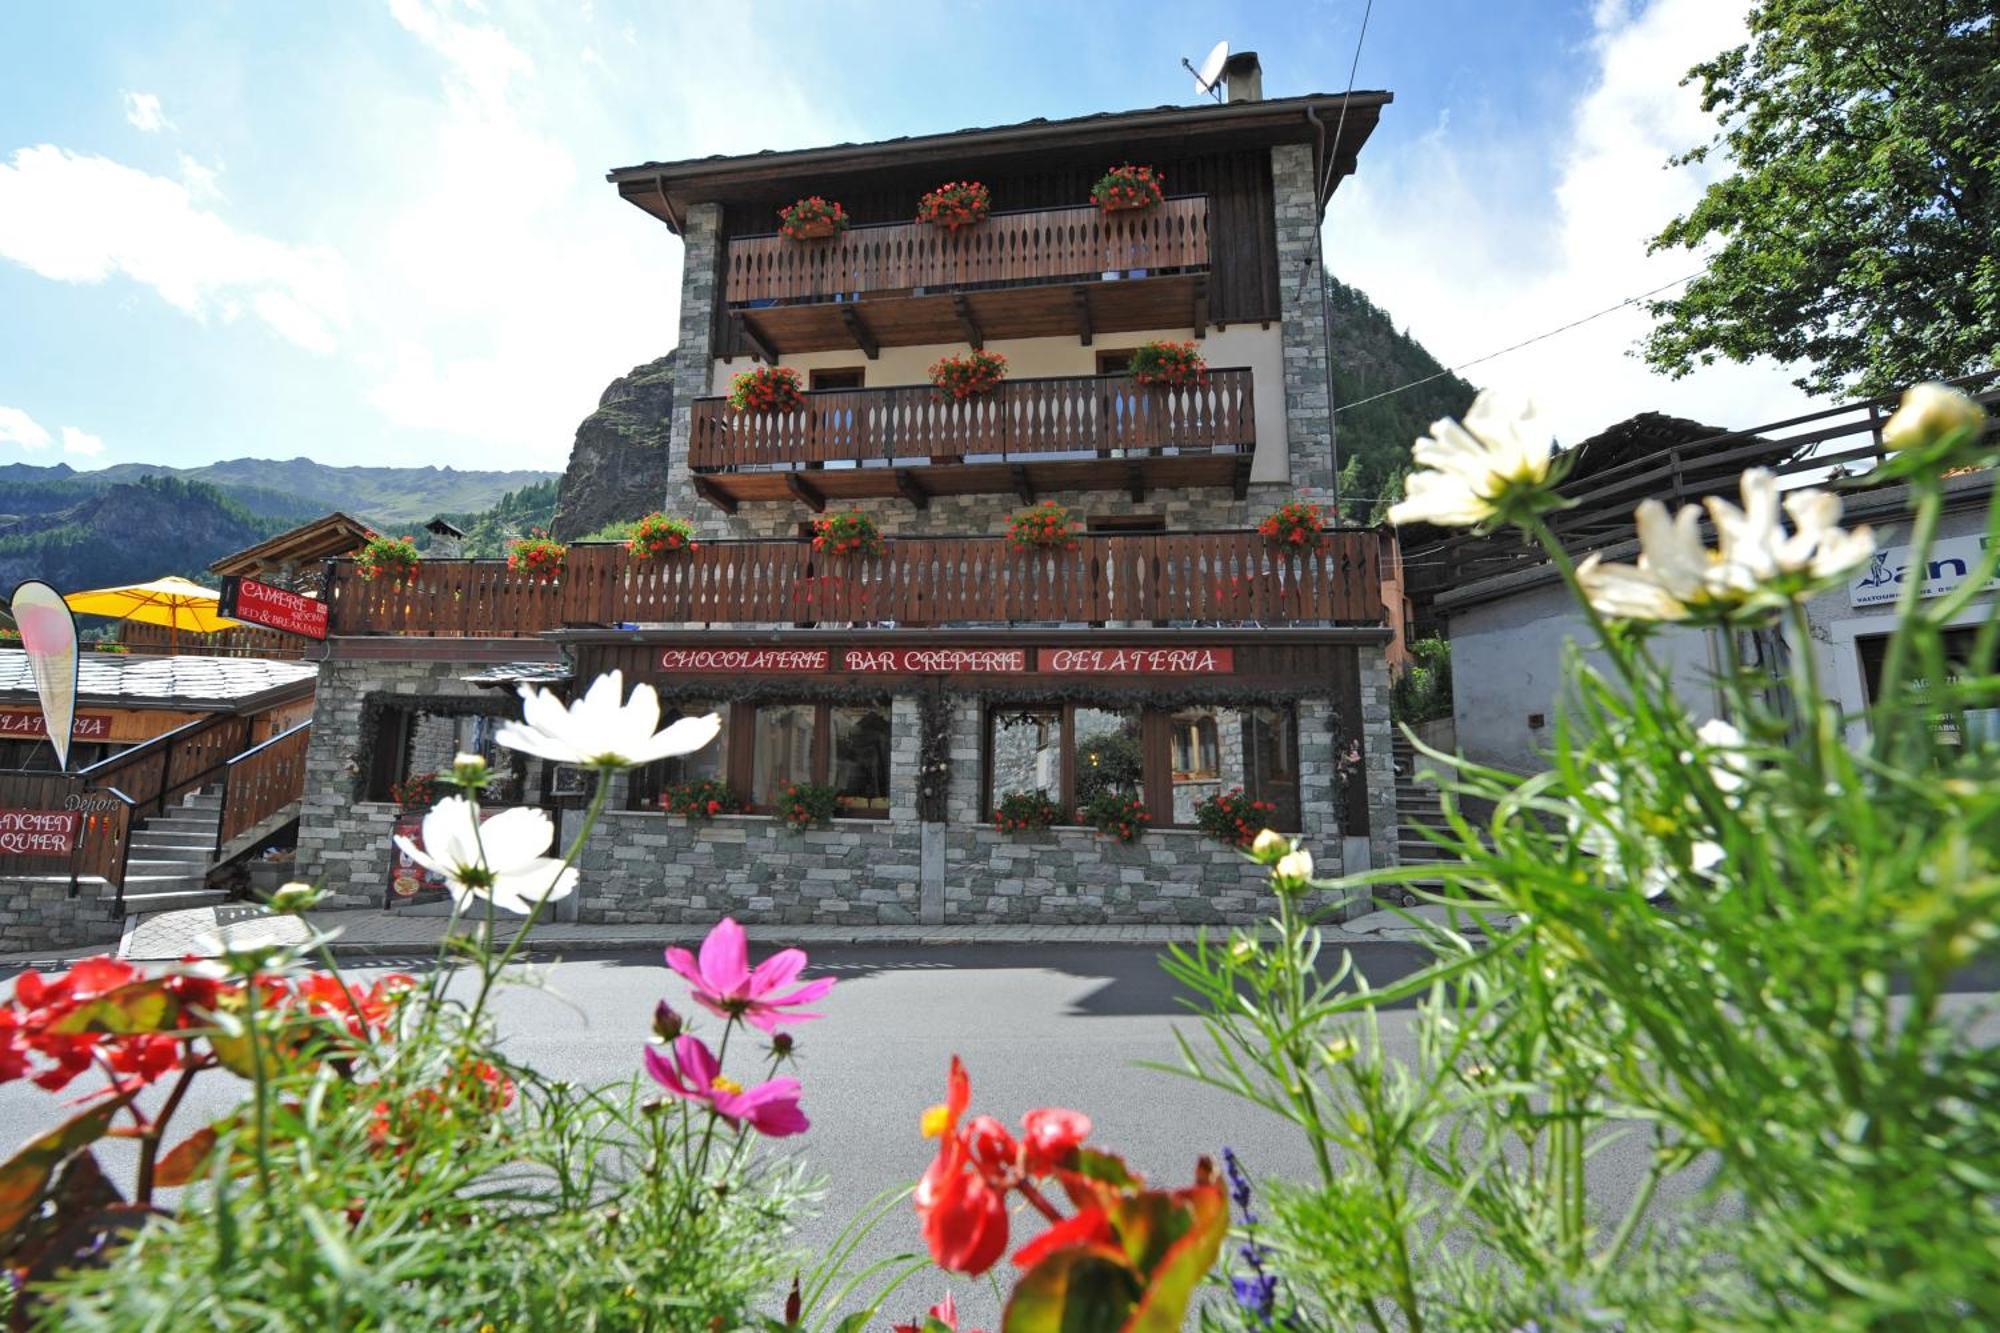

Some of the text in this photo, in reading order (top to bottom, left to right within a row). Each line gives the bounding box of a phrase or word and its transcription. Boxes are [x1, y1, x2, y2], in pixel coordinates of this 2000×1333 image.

[242, 582, 306, 612] CAMERE
[238, 607, 321, 635] BED & BREAKFAST
[662, 651, 827, 669] CHOCOLATERIE
[846, 651, 898, 671] BAR
[1052, 650, 1216, 671] GELATERIA
[64, 793, 120, 812] Dehors
